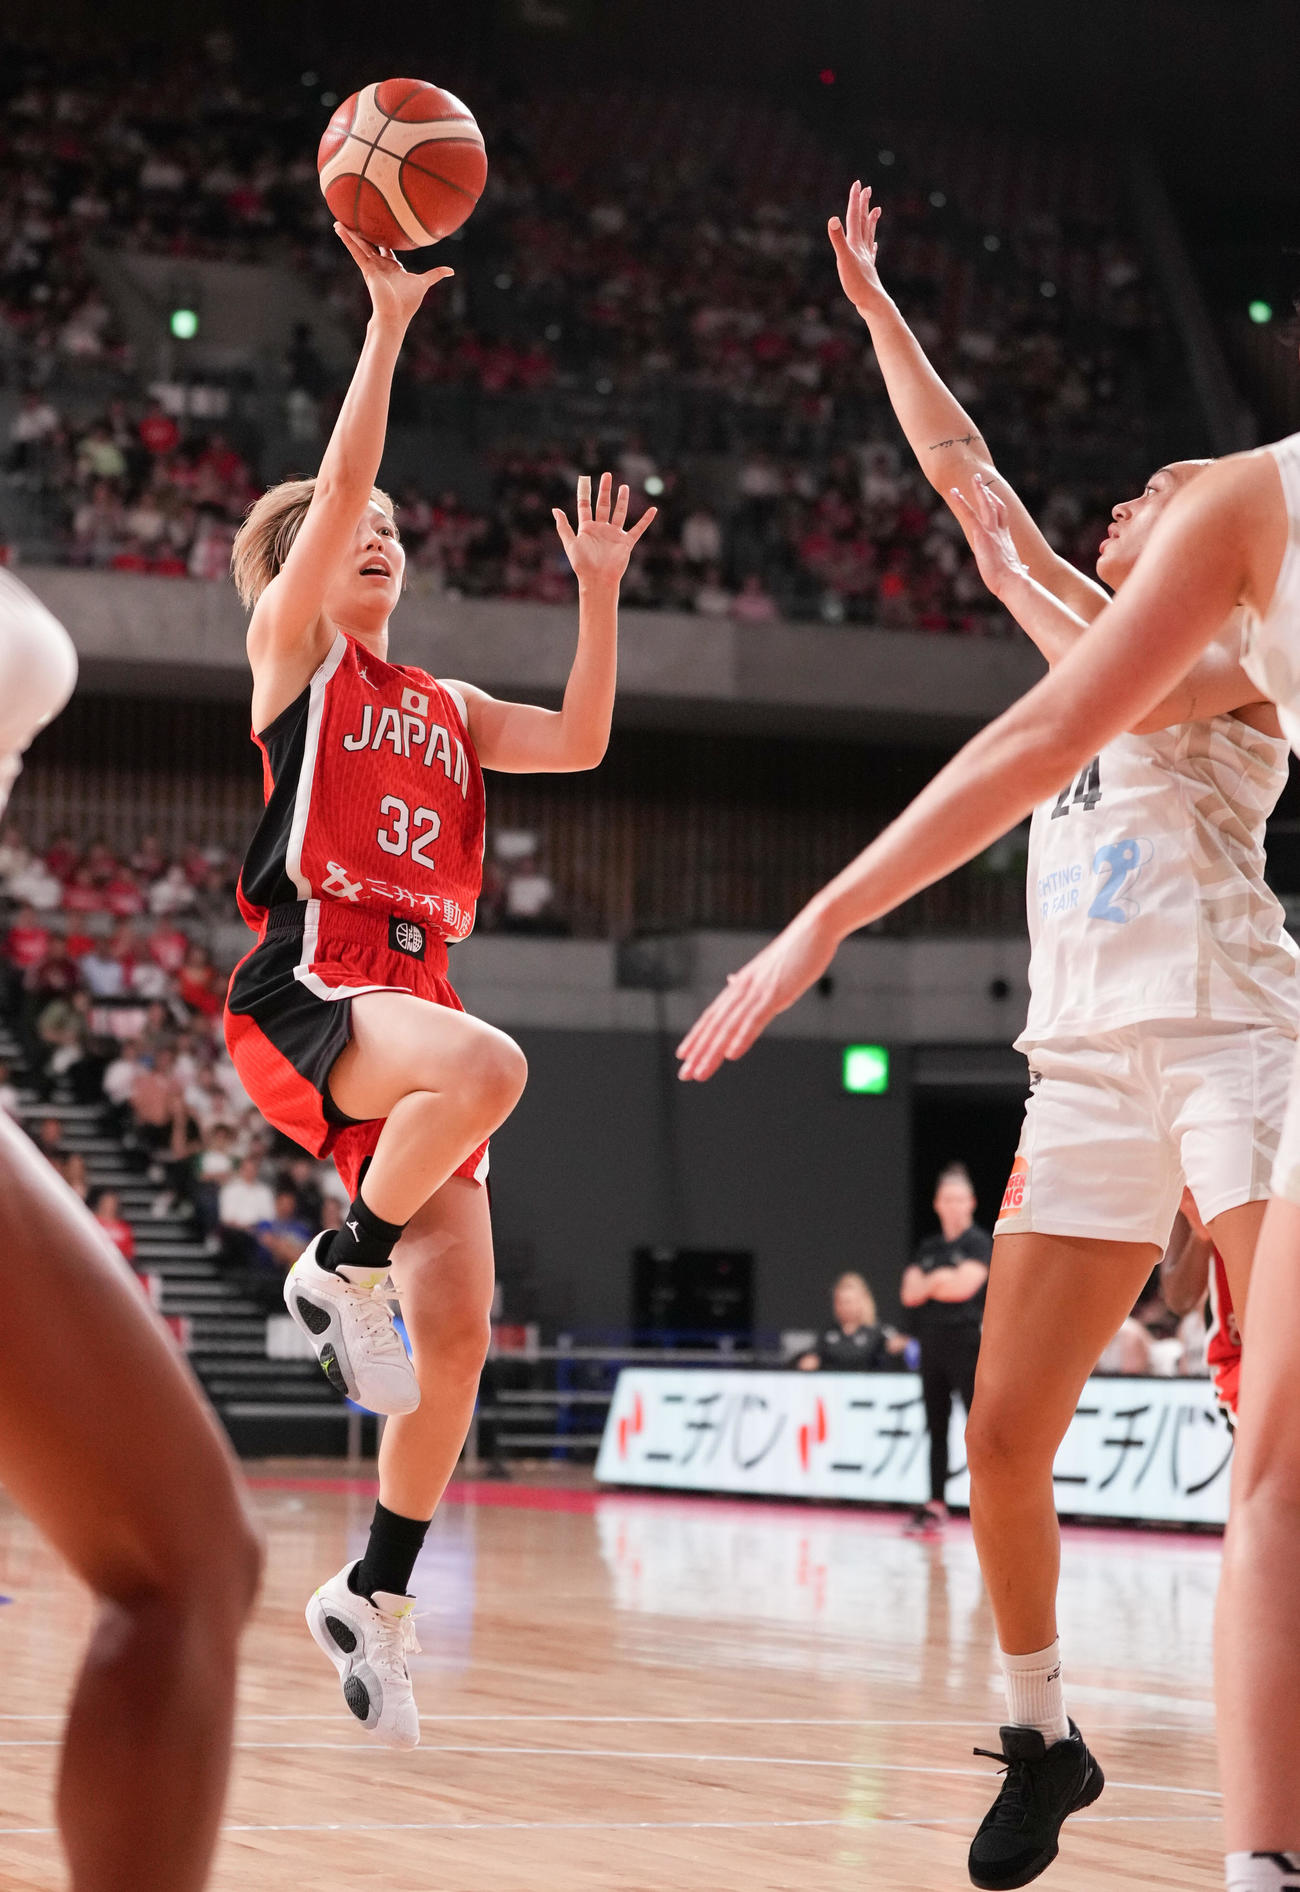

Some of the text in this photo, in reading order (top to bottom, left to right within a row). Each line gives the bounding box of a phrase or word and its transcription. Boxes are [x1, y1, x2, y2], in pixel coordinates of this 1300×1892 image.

[343, 704, 470, 800] JAPAN
[376, 793, 442, 870] 32
[1040, 902, 1049, 920] R
